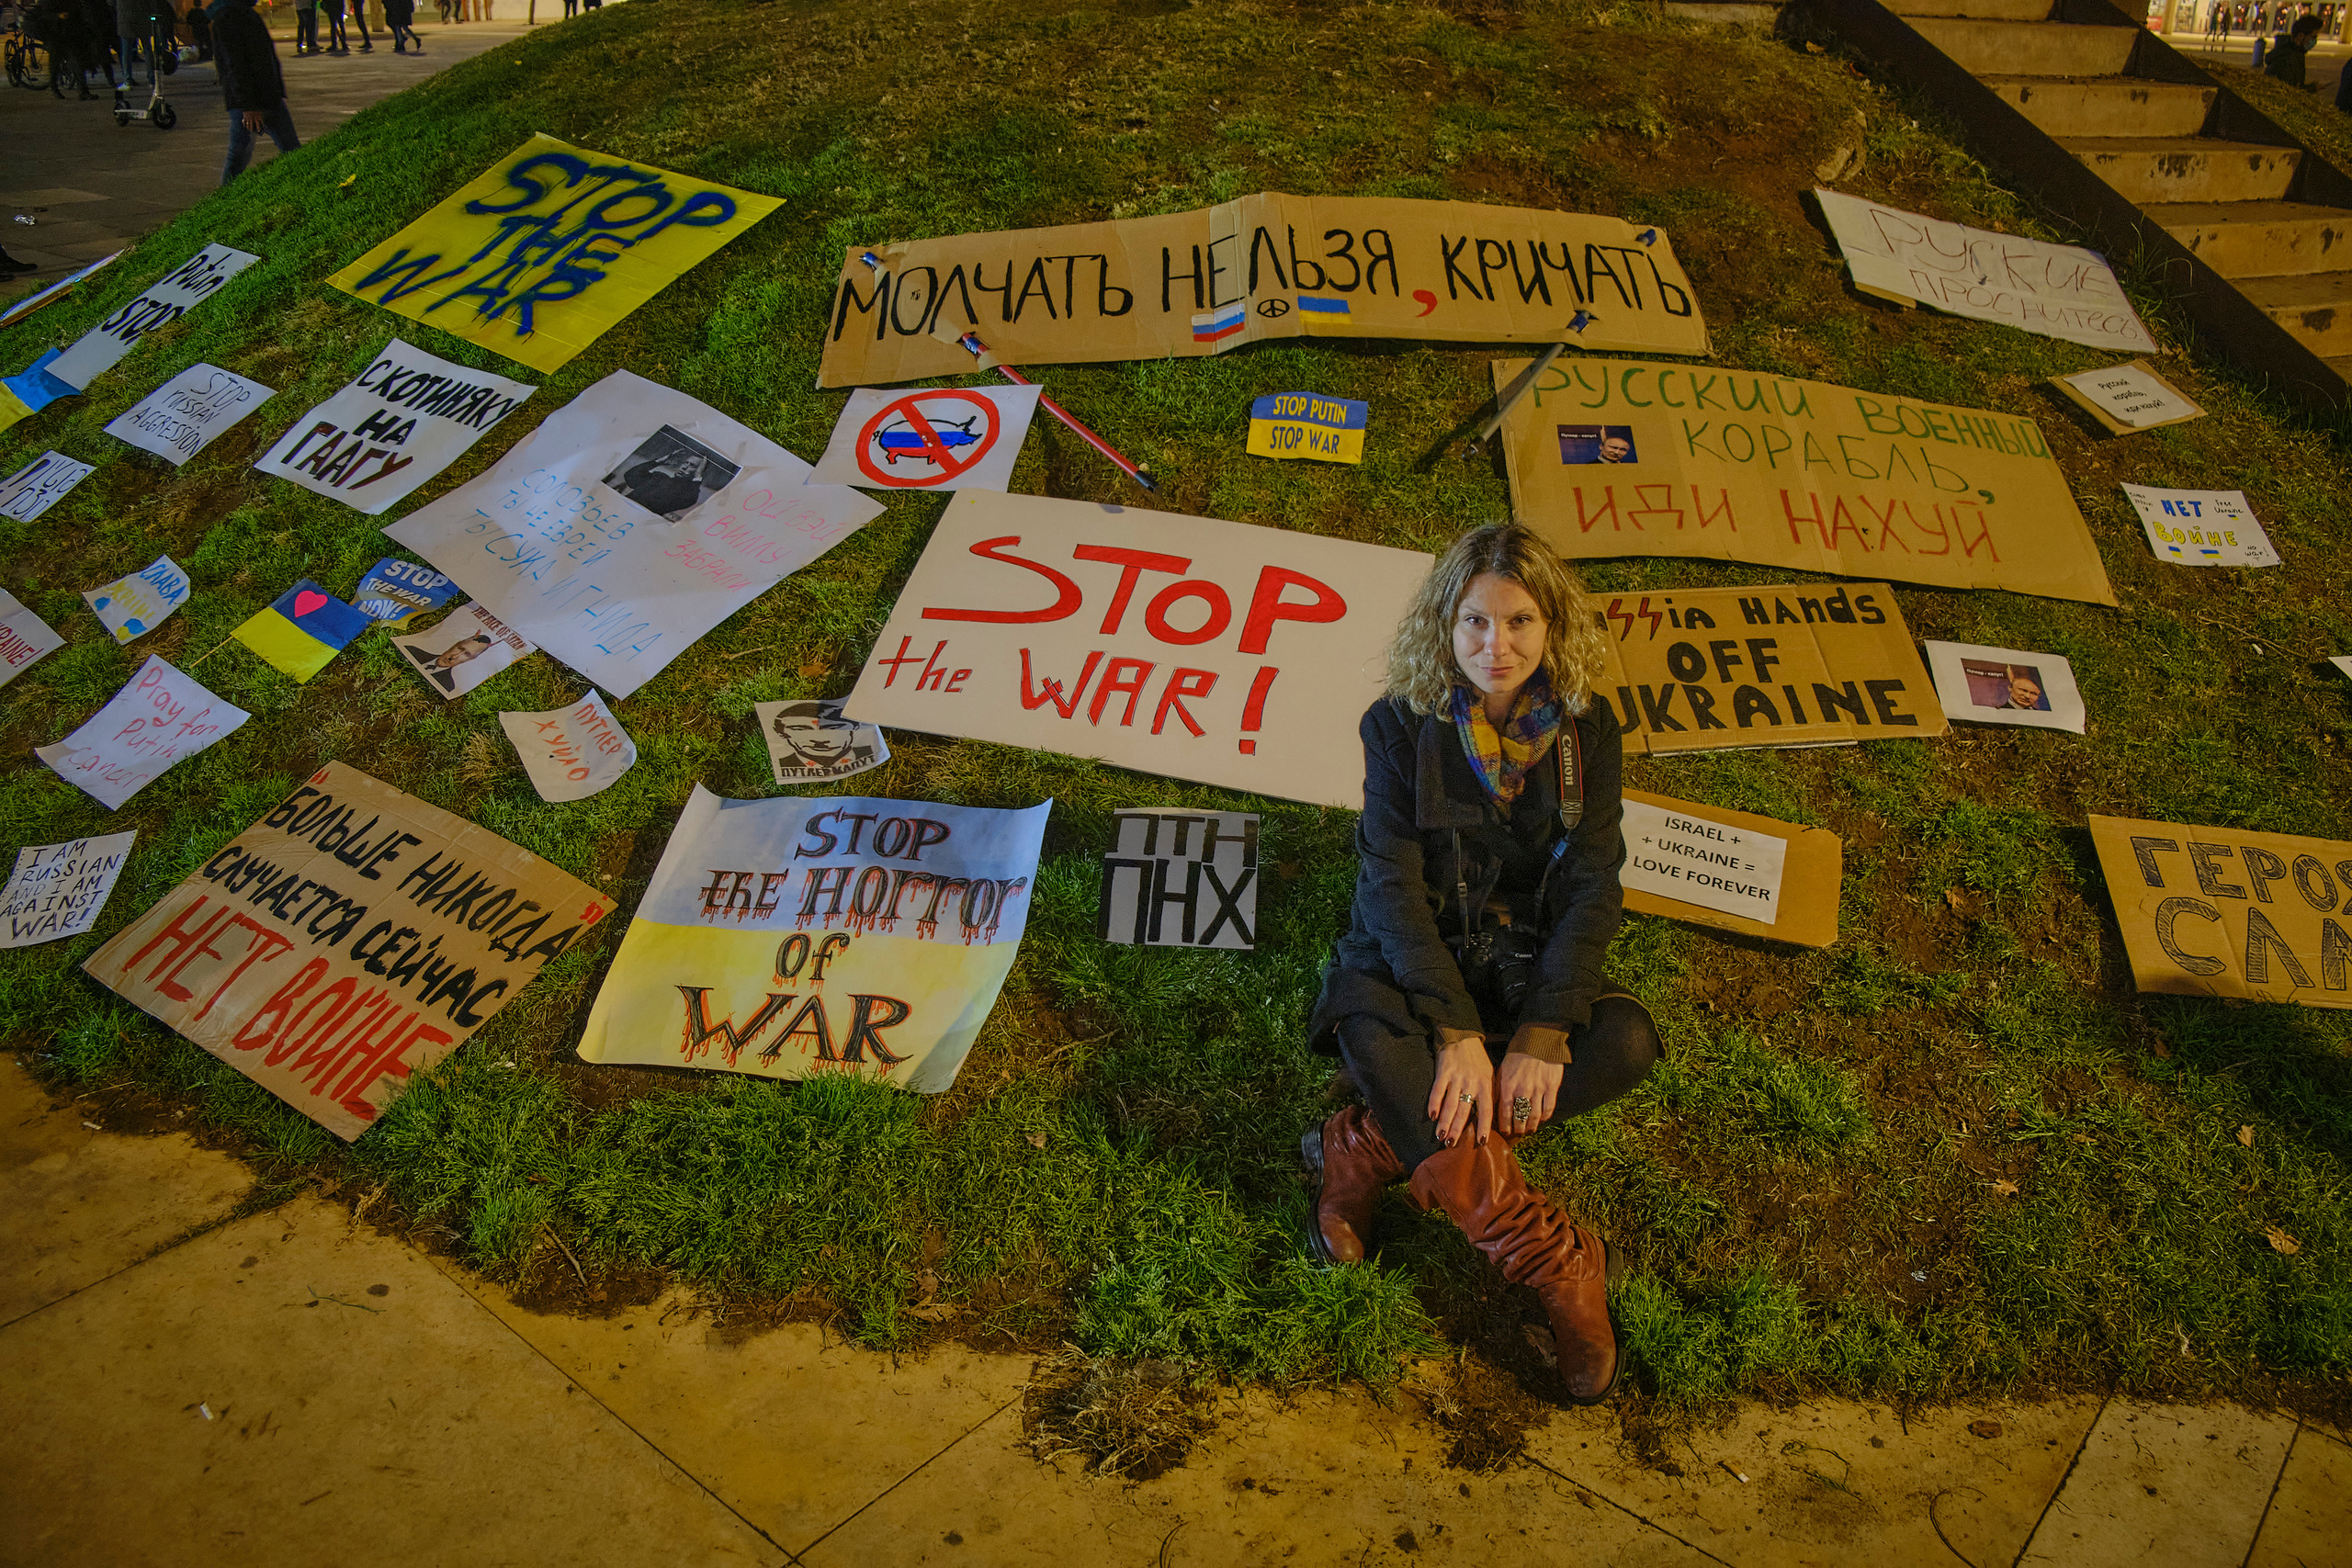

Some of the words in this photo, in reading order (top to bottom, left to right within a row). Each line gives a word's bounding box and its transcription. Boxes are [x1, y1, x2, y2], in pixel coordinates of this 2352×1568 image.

[465, 152, 736, 241] STOP
[355, 249, 606, 336] WAR
[833, 253, 1134, 341] МОЛЧАТЬ
[1441, 233, 1692, 318] КРИЧАТЬ
[190, 372, 251, 412] STOP
[356, 359, 523, 432] СКОТИНЯКУ
[1272, 396, 1307, 416] STOP
[1309, 399, 1347, 424] PUTIN
[1531, 364, 1815, 420] РУССКИЙ
[1854, 395, 2051, 460] ВОЕННЫЙ
[352, 408, 418, 445] НА
[1270, 426, 1304, 449] STOP
[1309, 429, 1340, 455] WAR
[280, 421, 414, 491] ГААГУ
[523, 468, 634, 539] СОЛОВЬЕВ
[743, 489, 801, 520] ОЙ
[1572, 483, 1737, 534] ИДИ
[1780, 487, 2001, 563] НАХУЙ
[2161, 499, 2202, 517] НЕТ
[541, 518, 614, 569] ЕВРЕЙ
[704, 514, 792, 564] ВИЛЛУ
[2152, 521, 2239, 547] ВОЙНЕ
[139, 563, 187, 606] СЛАВА
[384, 560, 449, 591] STOP
[485, 533, 558, 587] СУКА
[664, 538, 753, 592] ЗАБРАЛИ
[357, 599, 410, 620] NOW!
[365, 577, 394, 594] THE
[392, 587, 433, 607] WAR
[922, 535, 1348, 655] STOP
[878, 635, 973, 694] the
[1667, 637, 1781, 684] OFF
[573, 702, 623, 756] ПУТЛЕР
[1561, 734, 1574, 786] Canon
[794, 806, 952, 862] STOP
[1106, 813, 1260, 868] ПТН
[1658, 838, 1740, 870] UKRAINE
[1665, 816, 1725, 842] ISRAEL
[19, 853, 120, 886] RUSSIAN
[27, 848, 49, 869] I
[51, 840, 88, 863] AM
[1634, 856, 1681, 879] LOVE
[1687, 870, 1770, 901] FOREVER
[0, 889, 104, 918] AGAINST
[6, 883, 46, 904] AND
[51, 878, 66, 895] I
[71, 874, 103, 894] AM
[1097, 858, 1256, 945] ПНХ
[11, 907, 92, 940] WAR!
[202, 845, 368, 947] СЛУЧАЕТСЯ
[349, 919, 510, 1028] СЕЙЧАС
[120, 895, 296, 1021] НЕТ
[232, 954, 454, 1121] ВОЙНЕ
[674, 983, 914, 1069] WAR
